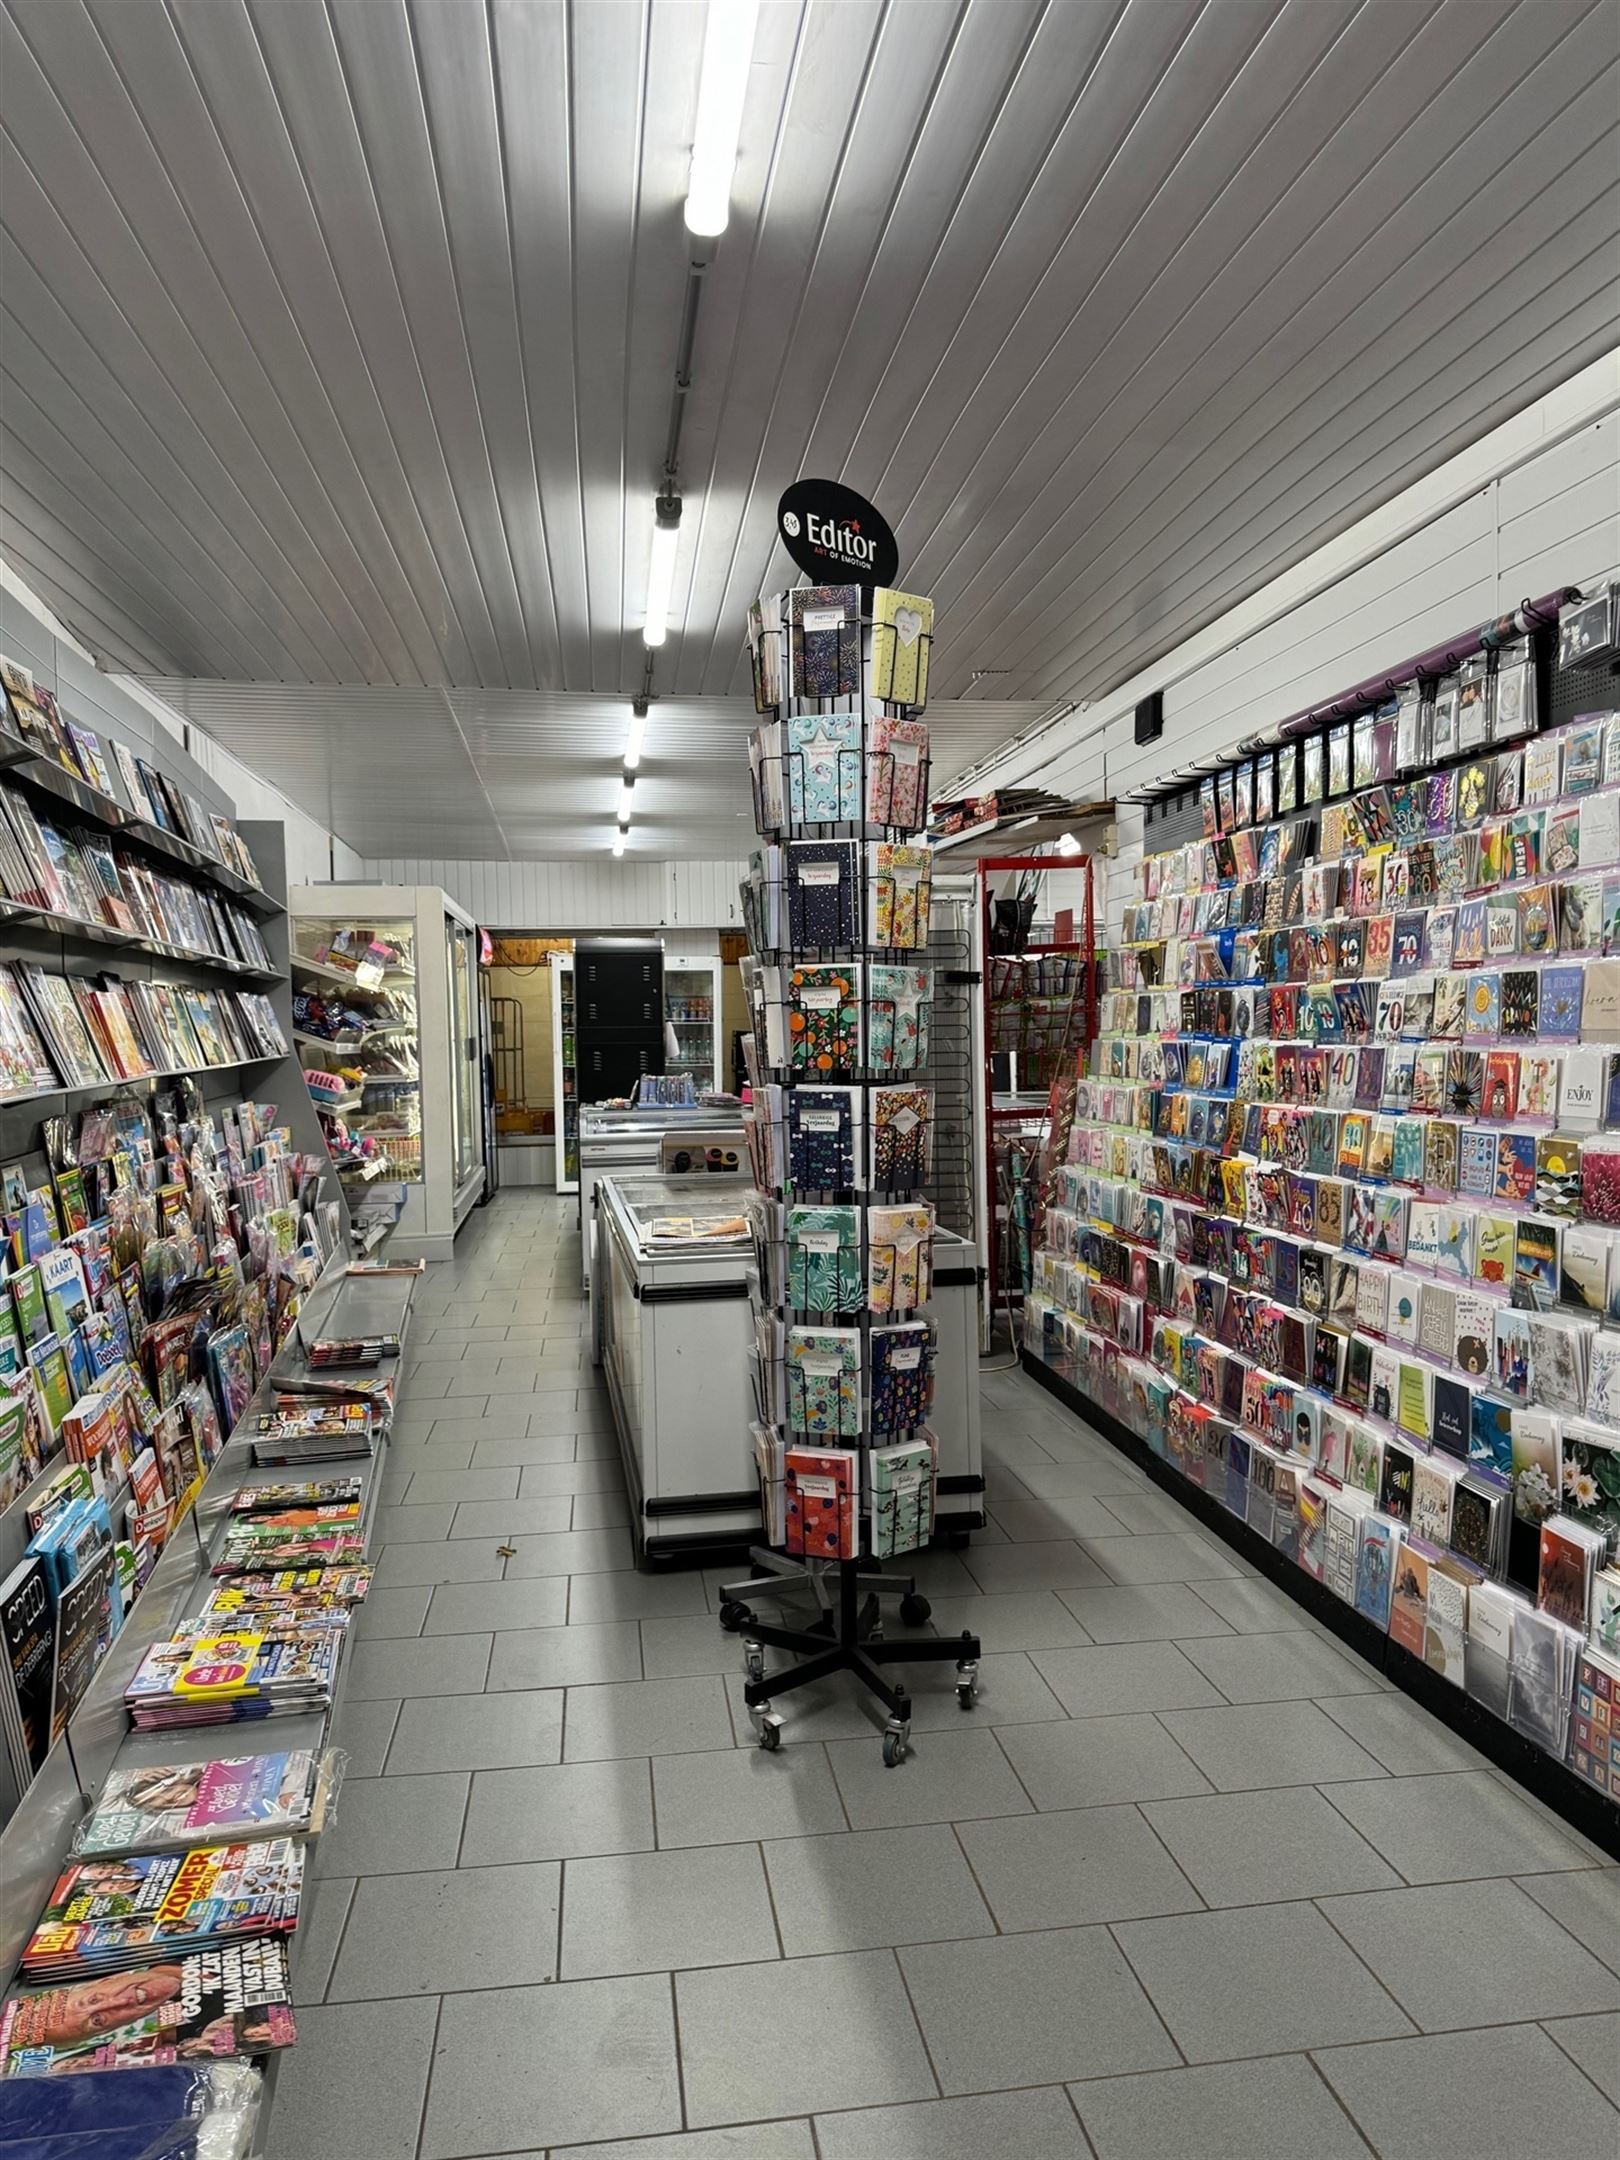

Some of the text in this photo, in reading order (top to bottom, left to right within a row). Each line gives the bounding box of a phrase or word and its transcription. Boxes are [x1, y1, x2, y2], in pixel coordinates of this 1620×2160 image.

[807, 513, 877, 562] Editor
[815, 546, 872, 571] ART OF EMOTION
[1367, 921, 1392, 955] 35
[1398, 934, 1418, 964] 70
[1490, 925, 1513, 948] DANK
[1378, 1001, 1403, 1032] 70
[1332, 1052, 1355, 1086] 40
[1567, 1085, 1594, 1101] ENJOY
[1293, 1202, 1313, 1232] 40
[1318, 1190, 1340, 1225] 85
[1408, 1239, 1438, 1252] BEDANKT
[1359, 1271, 1384, 1293] HAPPY
[1357, 1293, 1384, 1317] BIRTH
[1246, 1397, 1264, 1429] 50
[1253, 1457, 1276, 1497] 100
[160, 1853, 211, 1919] ZOMER
[194, 1867, 220, 1899] SPECIAL
[203, 1953, 221, 1976] ZAT
[223, 1946, 244, 2013] MAANDEN
[243, 1940, 263, 1990] VAST IN
[183, 1956, 201, 2017] GORDON:
